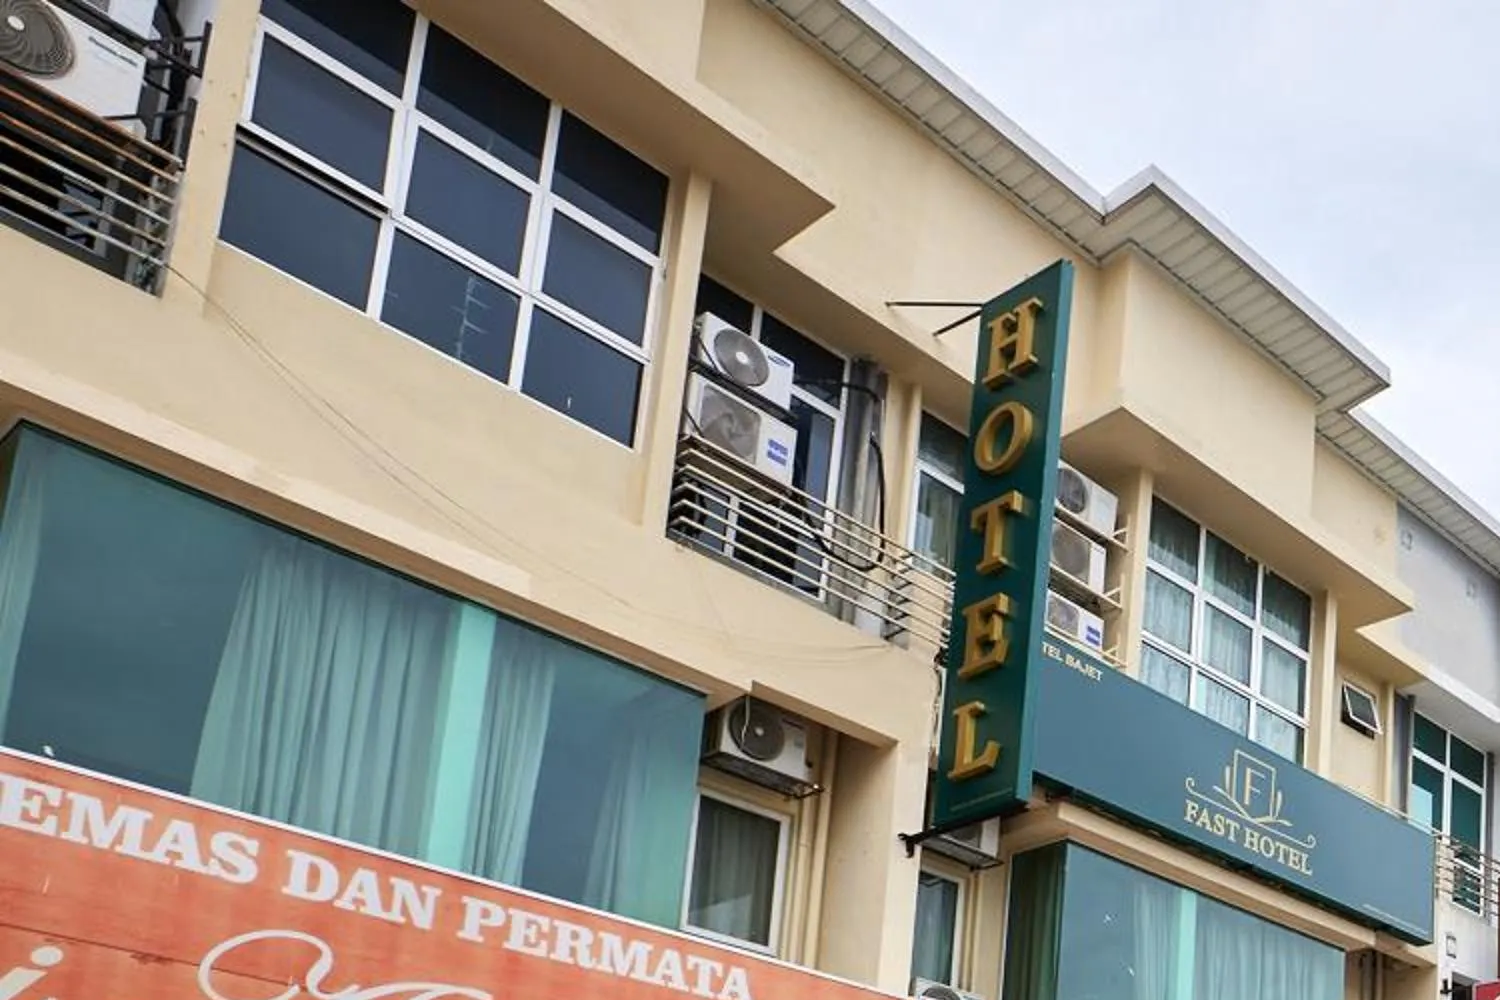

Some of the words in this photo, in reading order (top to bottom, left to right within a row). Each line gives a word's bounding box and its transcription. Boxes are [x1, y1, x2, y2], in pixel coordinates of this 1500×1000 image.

[945, 296, 1045, 782] HOTEL
[0, 771, 260, 884] EMAS
[281, 849, 442, 931] DAN
[1184, 799, 1240, 842] FAST
[1244, 828, 1313, 876] HOTEL
